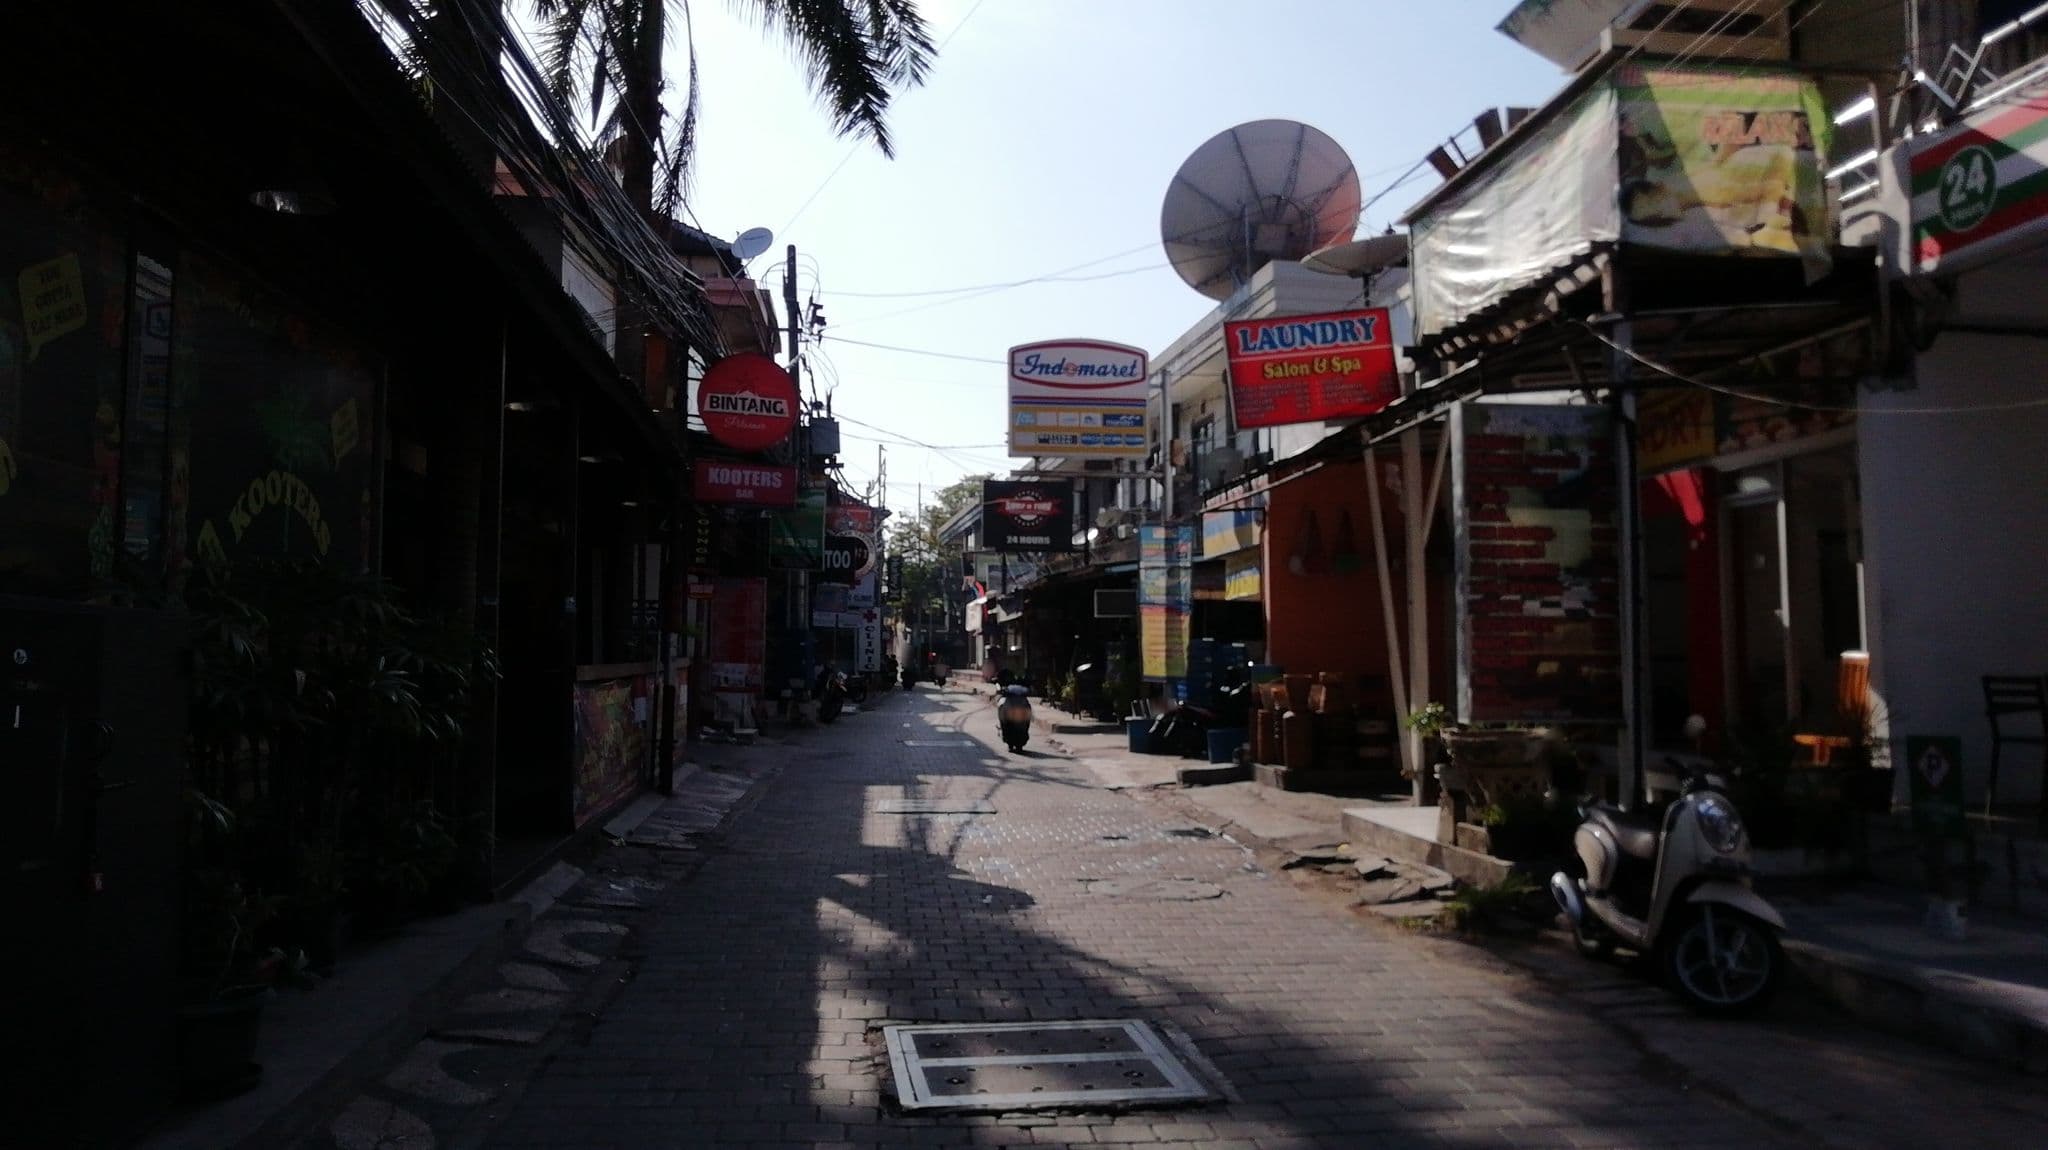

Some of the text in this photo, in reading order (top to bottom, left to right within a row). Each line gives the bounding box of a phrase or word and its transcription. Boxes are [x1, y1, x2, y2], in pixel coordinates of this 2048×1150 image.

[1945, 153, 1988, 206] 24
[1237, 315, 1377, 354] LAUNDRY
[1020, 353, 1138, 377] Indomaret
[1263, 355, 1361, 379] Salon & Spa
[709, 395, 786, 416] BINTANG
[708, 467, 783, 488] KOOTERS
[736, 488, 755, 499] BAR
[1006, 535, 1051, 545] 24 HOURS
[863, 625, 875, 671] CLINIC
